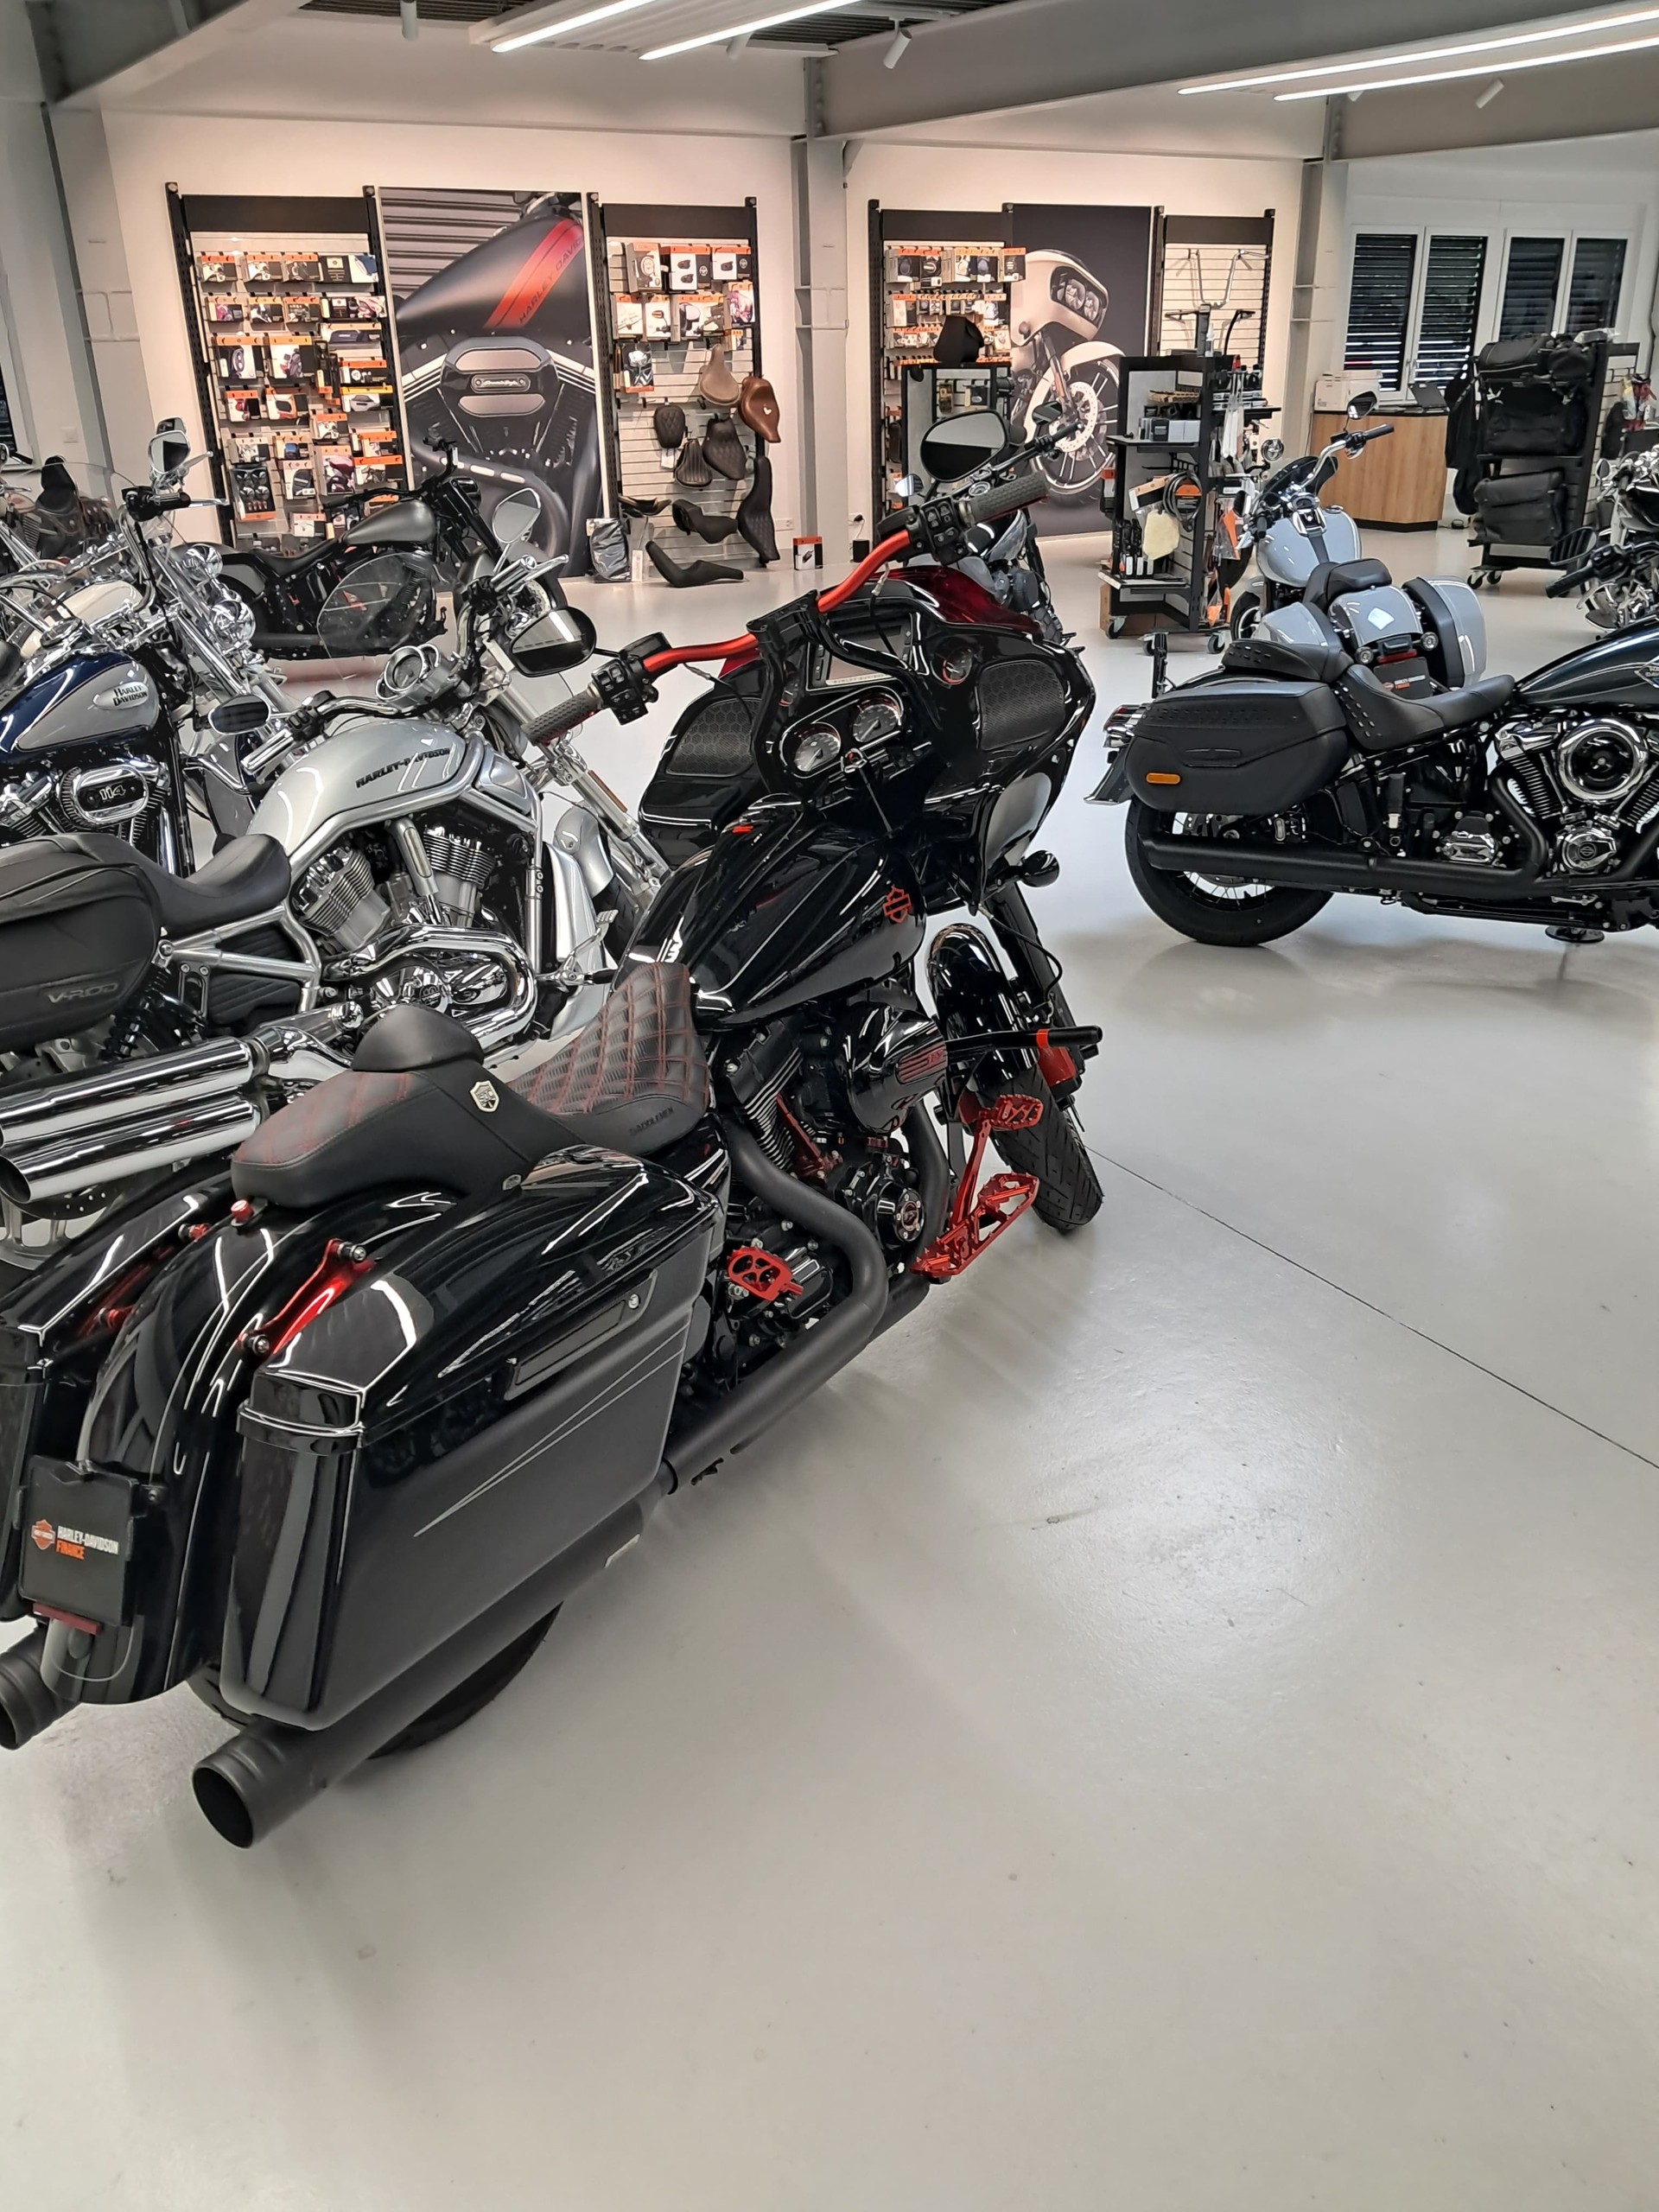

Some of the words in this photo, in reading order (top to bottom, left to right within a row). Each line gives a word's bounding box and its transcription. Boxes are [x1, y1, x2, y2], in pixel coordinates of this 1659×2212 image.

[112, 691, 148, 707] DAVIDSON
[99, 785, 126, 800] 114
[48, 982, 118, 1003] V-ROD
[57, 1525, 119, 1555] HARLEY-DAVIDSON
